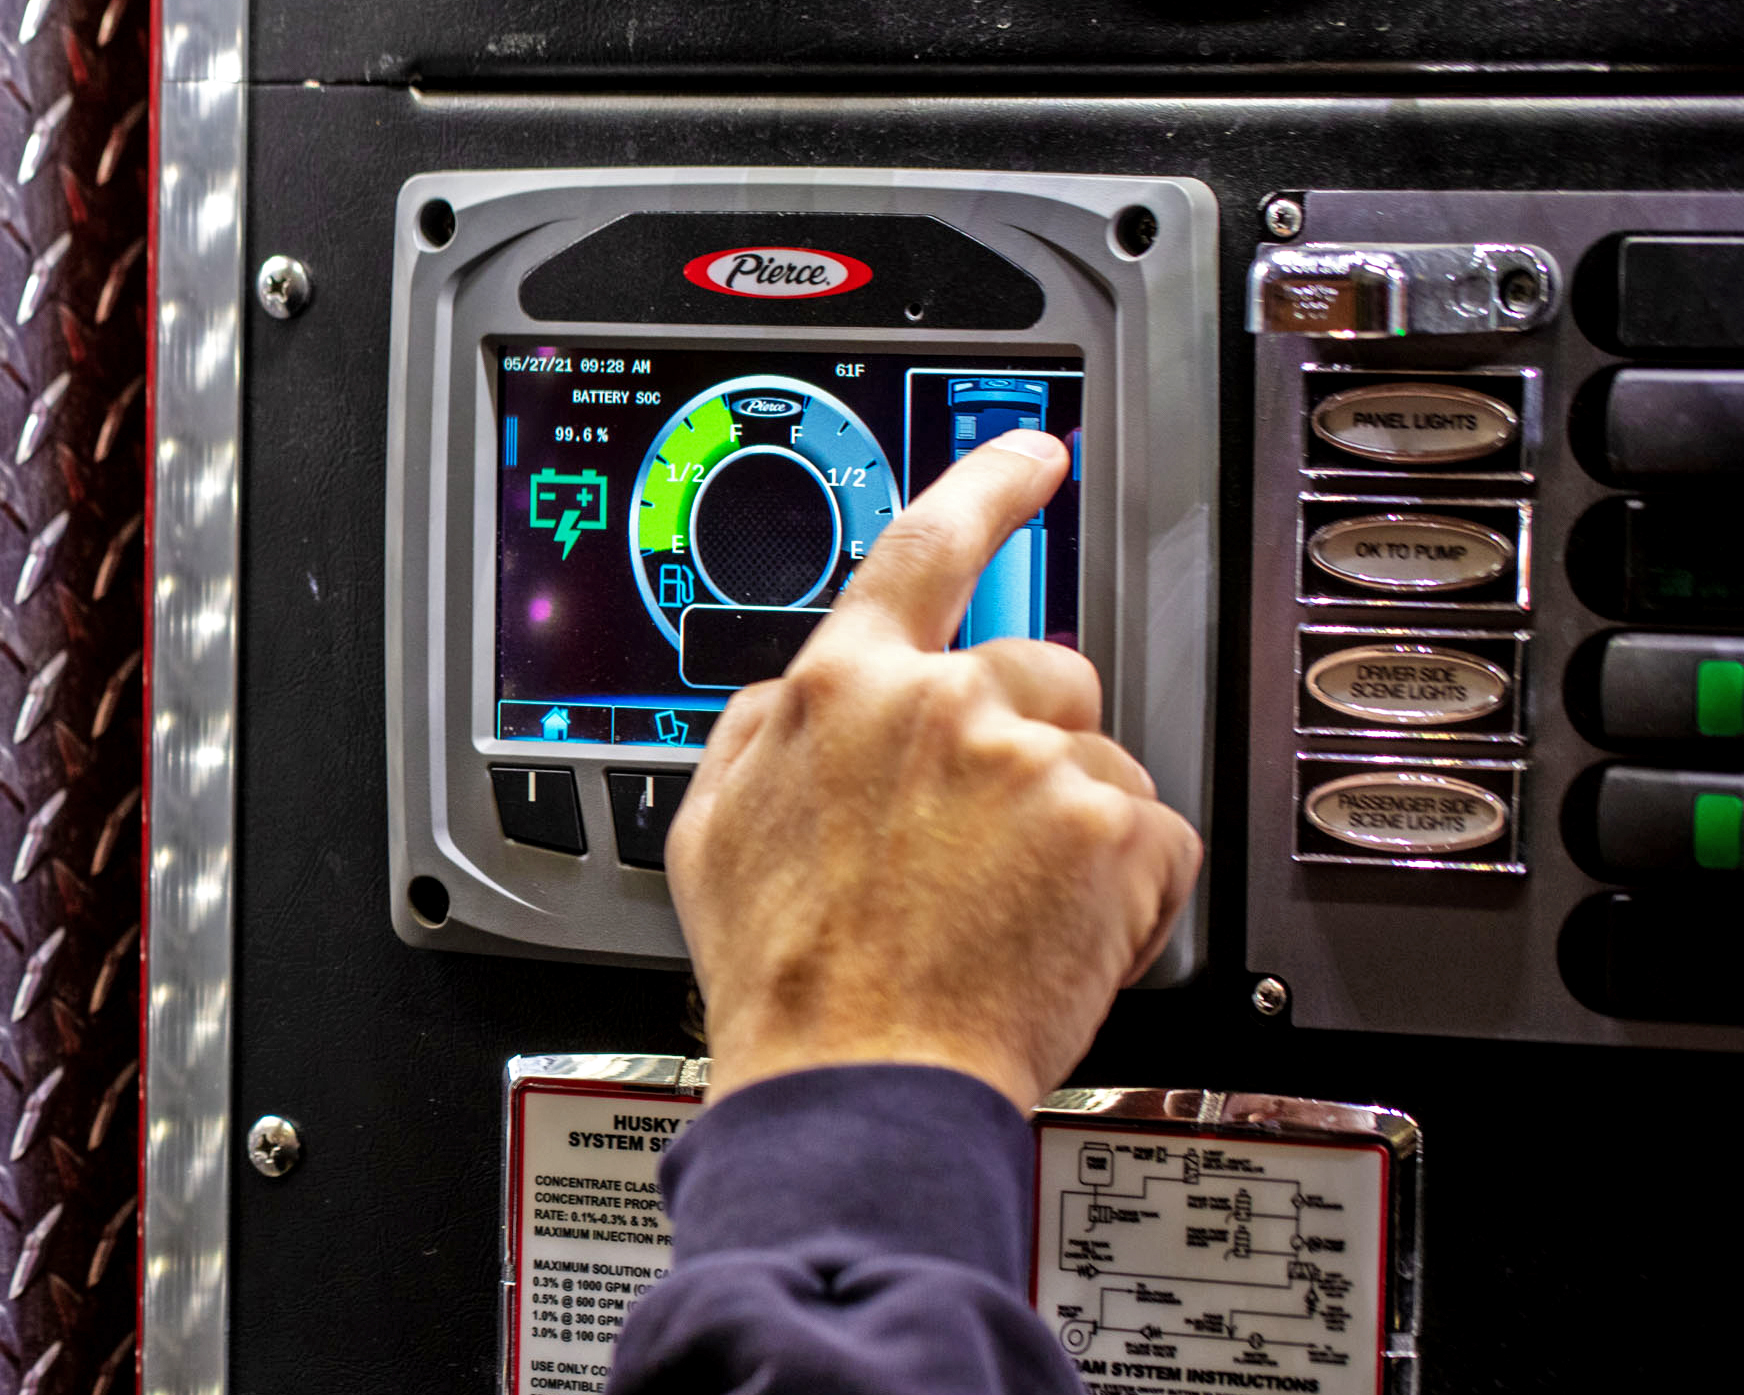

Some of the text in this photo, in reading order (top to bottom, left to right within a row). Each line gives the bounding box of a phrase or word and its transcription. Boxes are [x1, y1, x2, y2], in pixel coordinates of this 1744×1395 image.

[725, 253, 830, 289] Pierce
[504, 356, 651, 374] 05/27/21 09:28 AM
[835, 363, 865, 377] 61F
[572, 389, 661, 405] BATTERY SOC
[746, 400, 787, 413] Pierce
[1353, 411, 1478, 431] PANEL LIGHTS
[555, 426, 592, 442] 99.6
[729, 423, 743, 443] F
[790, 425, 803, 445] F
[666, 462, 705, 483] 1/2
[826, 466, 867, 488] 1/2
[671, 534, 685, 554] E
[850, 540, 865, 560] E
[1355, 541, 1468, 561] OK TO PUMP
[1357, 664, 1457, 684] DRIVER SIDE
[1350, 682, 1469, 702] SCENE LIGHTS
[1338, 793, 1478, 816] PASSENGER SIDE
[1349, 812, 1466, 833] SCENE LIGHTS
[613, 1114, 680, 1134] HUSKY
[568, 1131, 644, 1151] SYSTEM
[535, 1175, 622, 1192] CONCENTRATE
[534, 1192, 621, 1209] CONCENTRATE
[534, 1208, 568, 1222] RATE:
[630, 1215, 639, 1227] &
[641, 1216, 659, 1229] 3%
[534, 1225, 590, 1240] MAXIMUM
[592, 1230, 654, 1245] INJECTION
[533, 1259, 590, 1274] MAXIMUM
[592, 1263, 651, 1279] SOLUTION
[532, 1276, 559, 1289] 0.3%
[561, 1278, 574, 1292] @
[576, 1279, 602, 1292] 1000
[605, 1282, 631, 1294] GPM
[532, 1293, 558, 1306] 0.5%
[561, 1295, 573, 1309] @
[575, 1296, 595, 1308] 600
[598, 1298, 624, 1310] GPM
[532, 1310, 624, 1327] 1.0% @ 300 GPM
[531, 1326, 558, 1340] 3.0%
[560, 1328, 573, 1342] @
[575, 1330, 594, 1342] 100
[530, 1360, 555, 1373] USE
[557, 1362, 589, 1375] ONLY
[1110, 1360, 1182, 1382] SYSTEM
[1186, 1368, 1321, 1394] INSTRUCTIONS
[530, 1377, 605, 1393] COMPATIBLE
